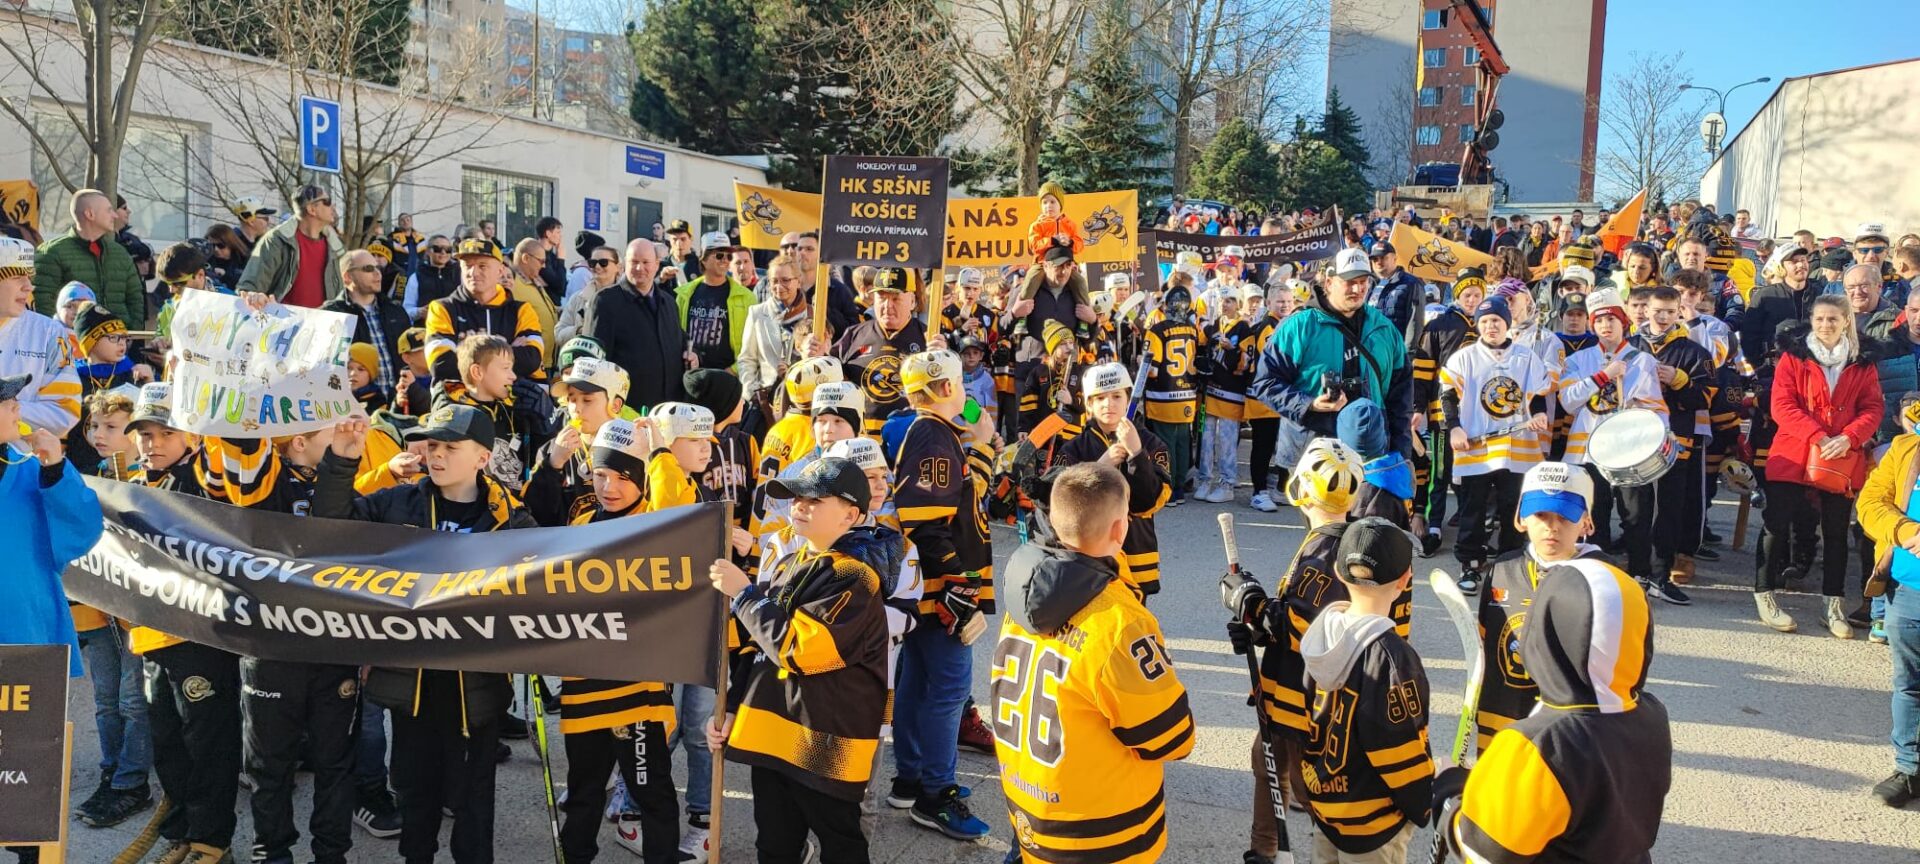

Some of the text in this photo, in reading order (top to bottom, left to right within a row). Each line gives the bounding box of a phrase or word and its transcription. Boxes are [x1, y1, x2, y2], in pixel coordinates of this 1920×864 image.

[312, 106, 330, 146] P
[840, 175, 931, 196] HK SRŠNE
[851, 199, 917, 220] KOŠICE
[964, 203, 1019, 228] NÁS
[856, 241, 910, 262] HP 3
[946, 235, 1034, 259] ŤAHUJ
[1274, 239, 1328, 254] PLOCHOU
[196, 311, 250, 350] MY
[181, 376, 247, 425] NOVÚ
[610, 425, 632, 435] ARENA
[852, 445, 873, 454] ARENA
[919, 457, 950, 488] 38
[313, 564, 420, 598] CHCE
[428, 554, 539, 597] HRAŤ
[544, 556, 694, 594] HOKEJ
[908, 559, 920, 590] 7
[1297, 565, 1333, 608] 77
[140, 566, 227, 622] DOMA
[234, 595, 252, 626] S
[259, 603, 462, 641] MOBILOM
[464, 616, 496, 639] V
[509, 612, 628, 641] RUKE
[991, 634, 1071, 769] 26
[1262, 741, 1286, 820] BAUER
